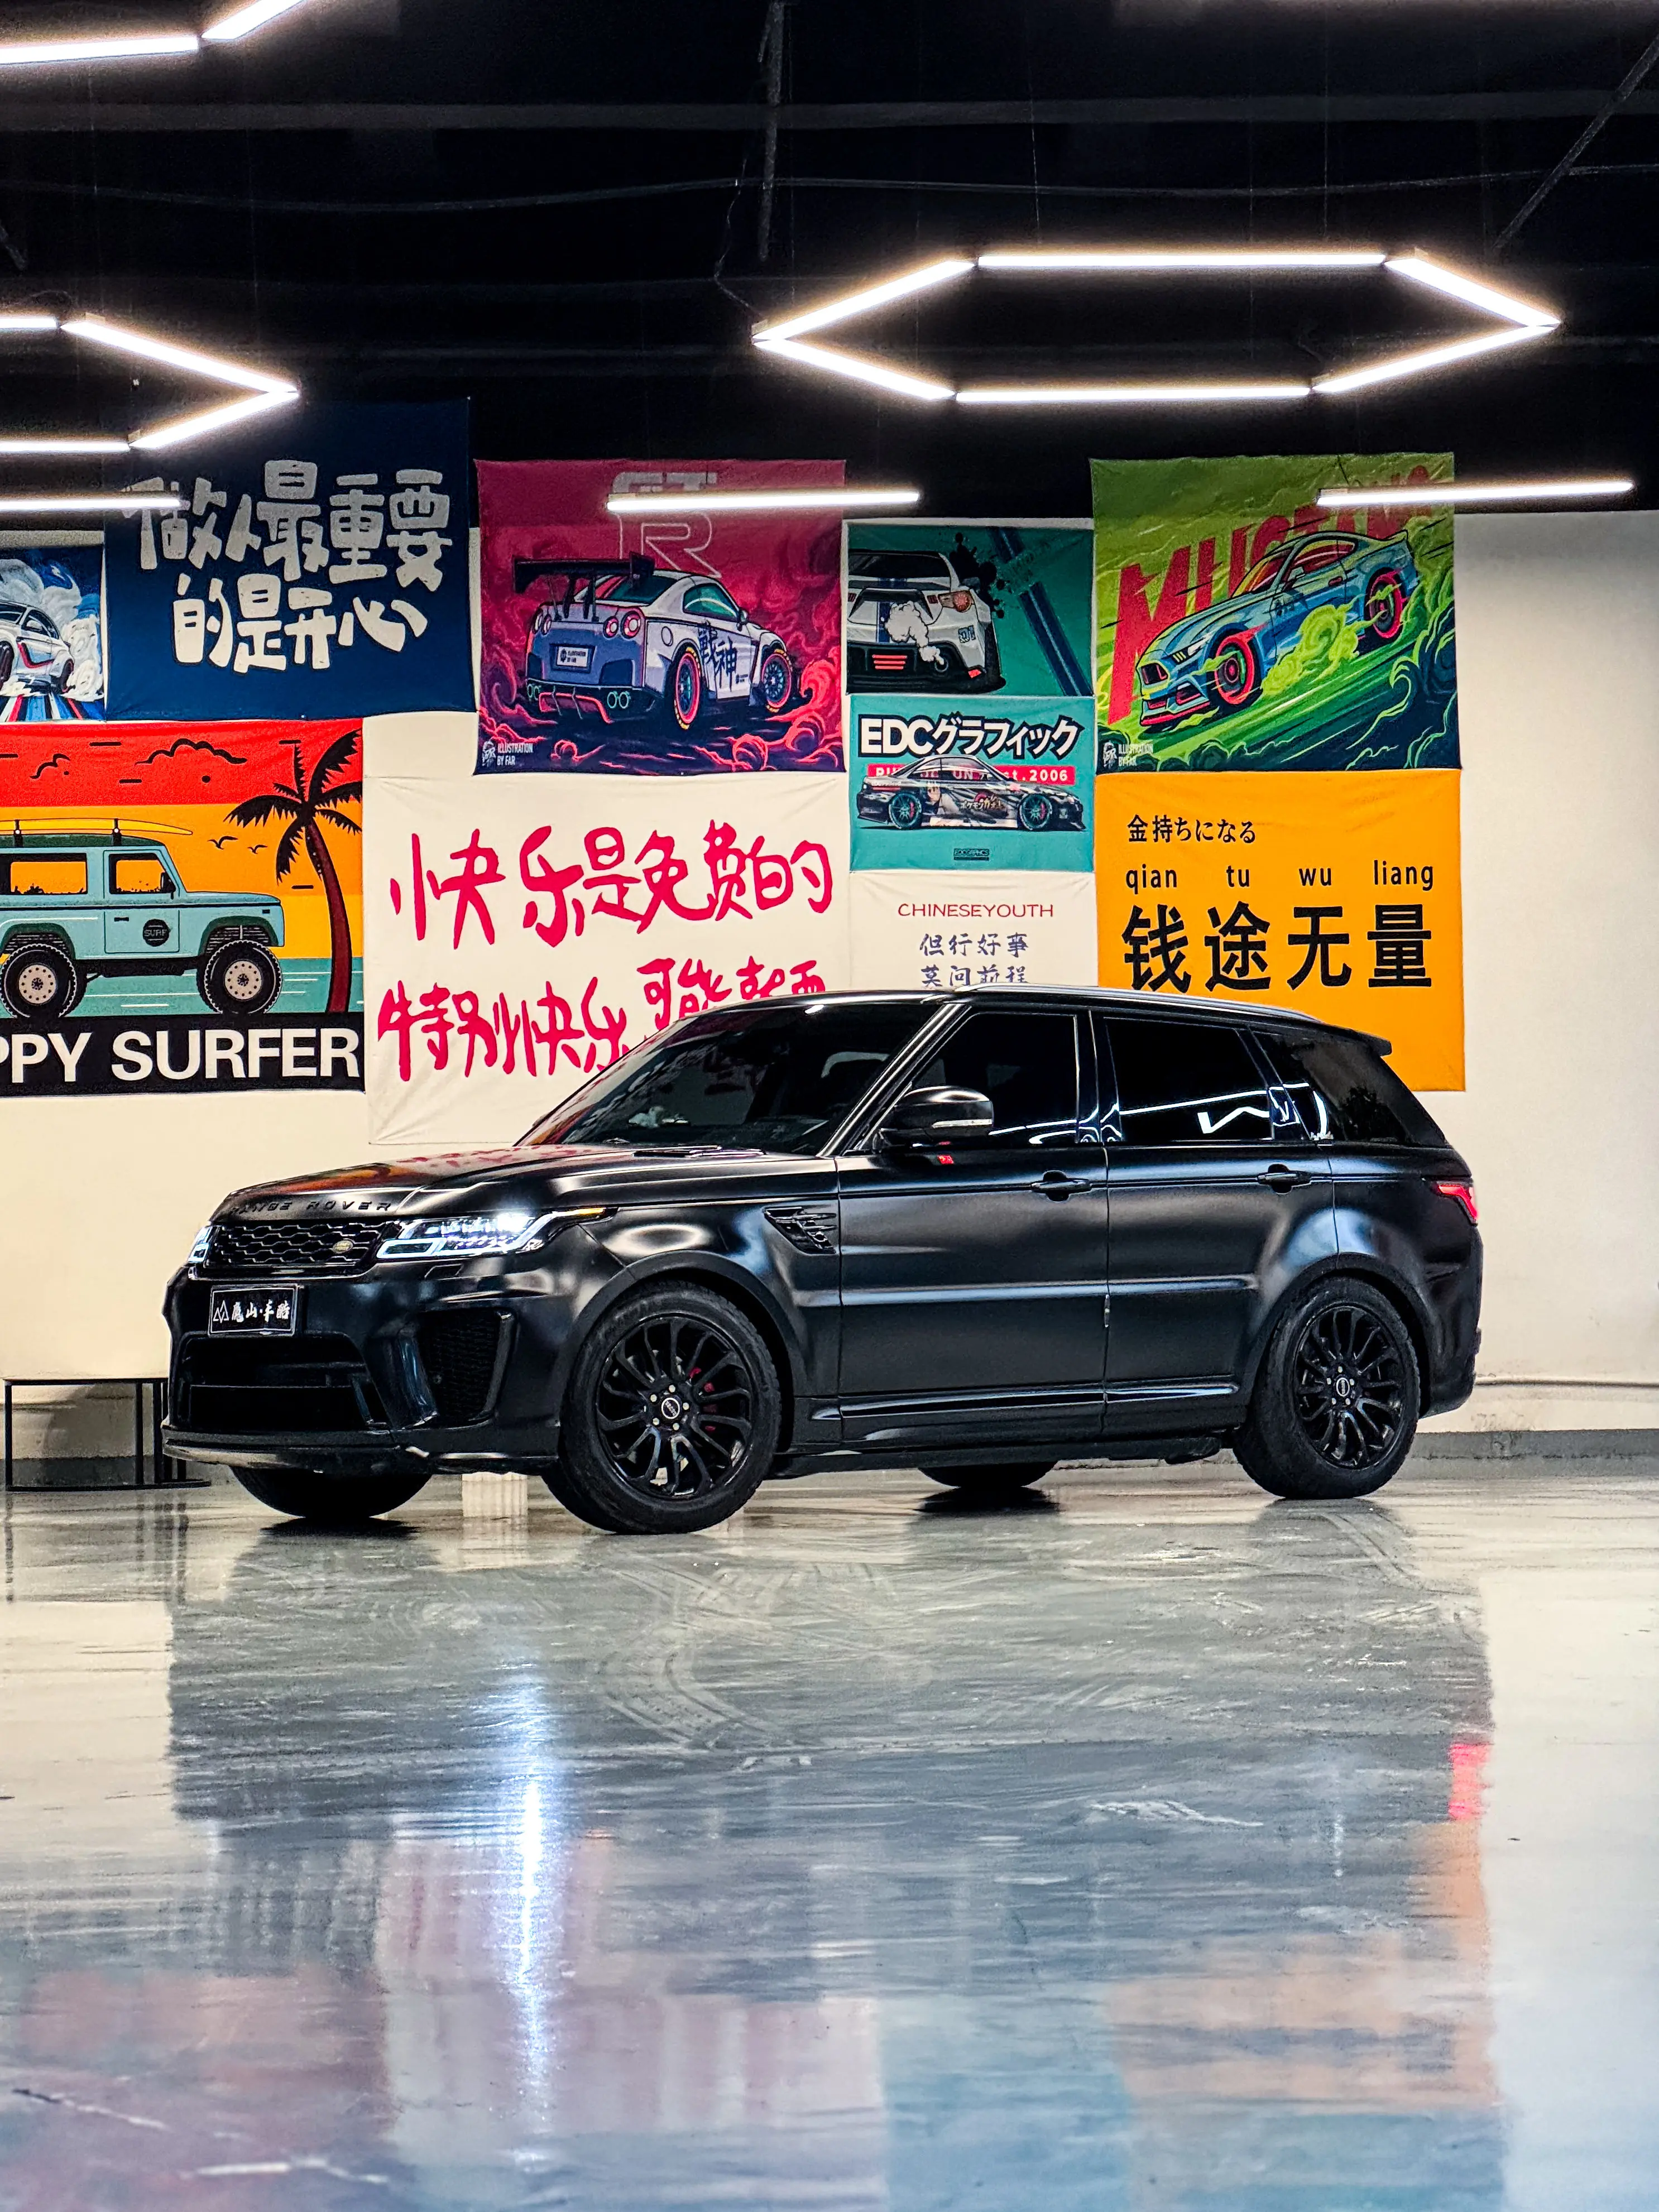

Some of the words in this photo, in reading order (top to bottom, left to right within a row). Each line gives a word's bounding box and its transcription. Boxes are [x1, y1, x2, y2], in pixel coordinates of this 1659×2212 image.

[121, 459, 453, 592] 做人最重要
[172, 573, 428, 673] 的是开心
[497, 742, 533, 754] ILLUSTRATION
[860, 717, 1081, 757] EDCグラフィック
[497, 755, 504, 766] BY
[505, 755, 516, 766] FAR
[1127, 814, 1257, 844] 金持ちになる
[390, 819, 833, 949] 快乐是免费的
[1125, 863, 1177, 894] qian
[1226, 865, 1250, 887] tu
[1299, 866, 1332, 886] wu
[1374, 860, 1433, 891] liang
[898, 903, 1054, 918] CHINESEYOUTH
[919, 932, 1029, 958] 但行好事
[1121, 901, 1433, 994] 钱途无量
[0, 1032, 93, 1083] PY
[111, 1028, 360, 1081] SURFER
[306, 1200, 391, 1211] ROVER
